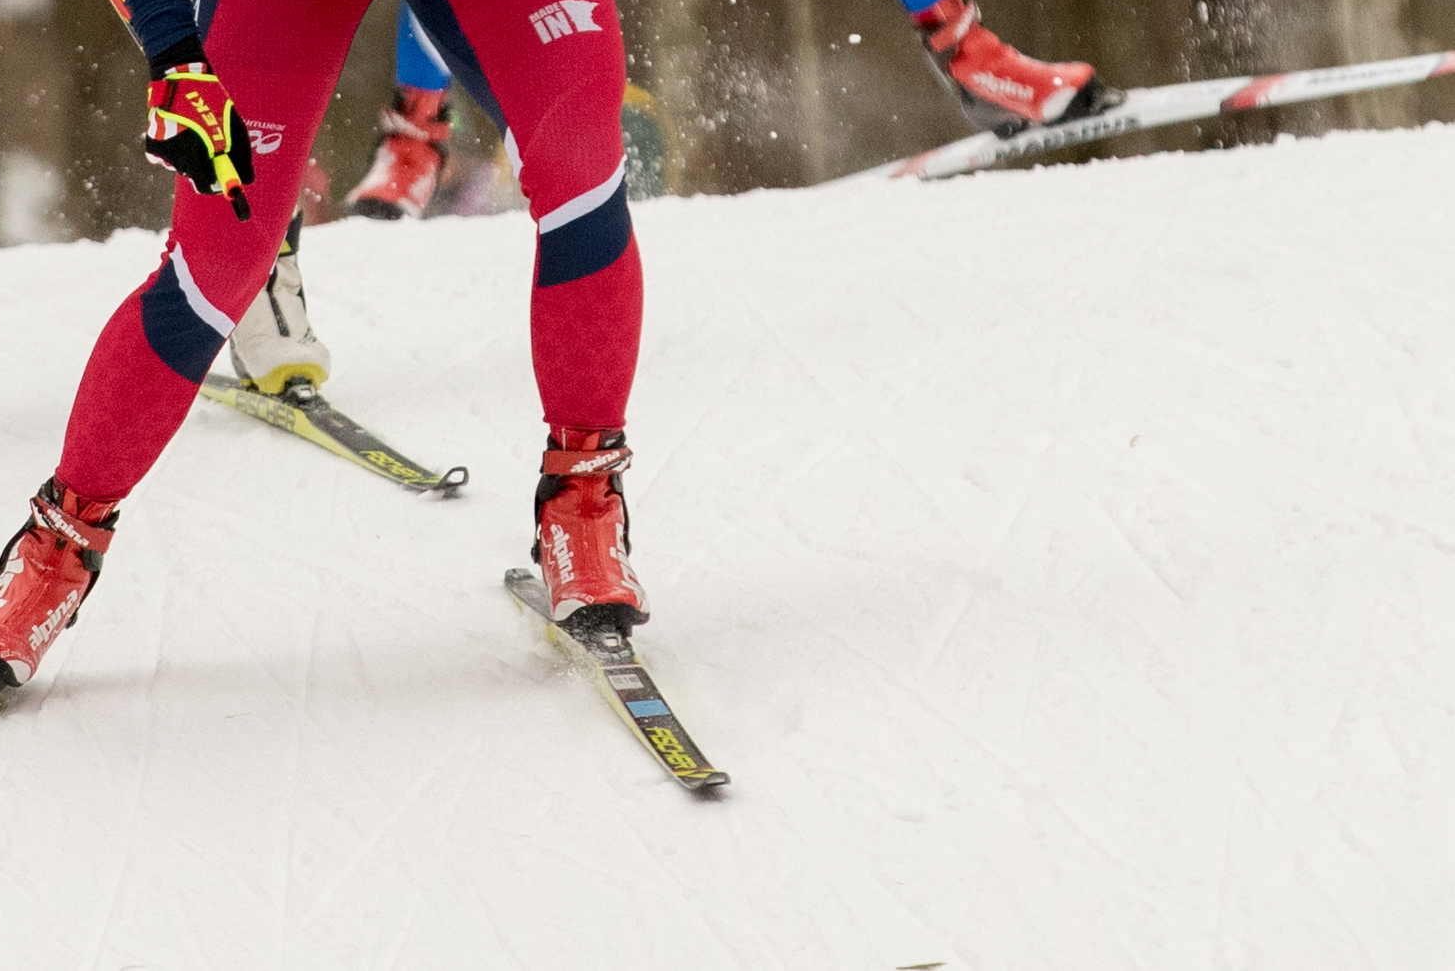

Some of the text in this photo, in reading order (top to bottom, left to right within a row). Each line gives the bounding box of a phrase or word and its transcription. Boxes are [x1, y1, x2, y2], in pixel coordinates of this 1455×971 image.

[533, 10, 574, 45] IN
[185, 91, 224, 143] LEKI
[570, 450, 621, 474] alpina
[46, 508, 90, 547] alpina
[550, 523, 576, 585] alpina
[28, 589, 78, 652] alpina
